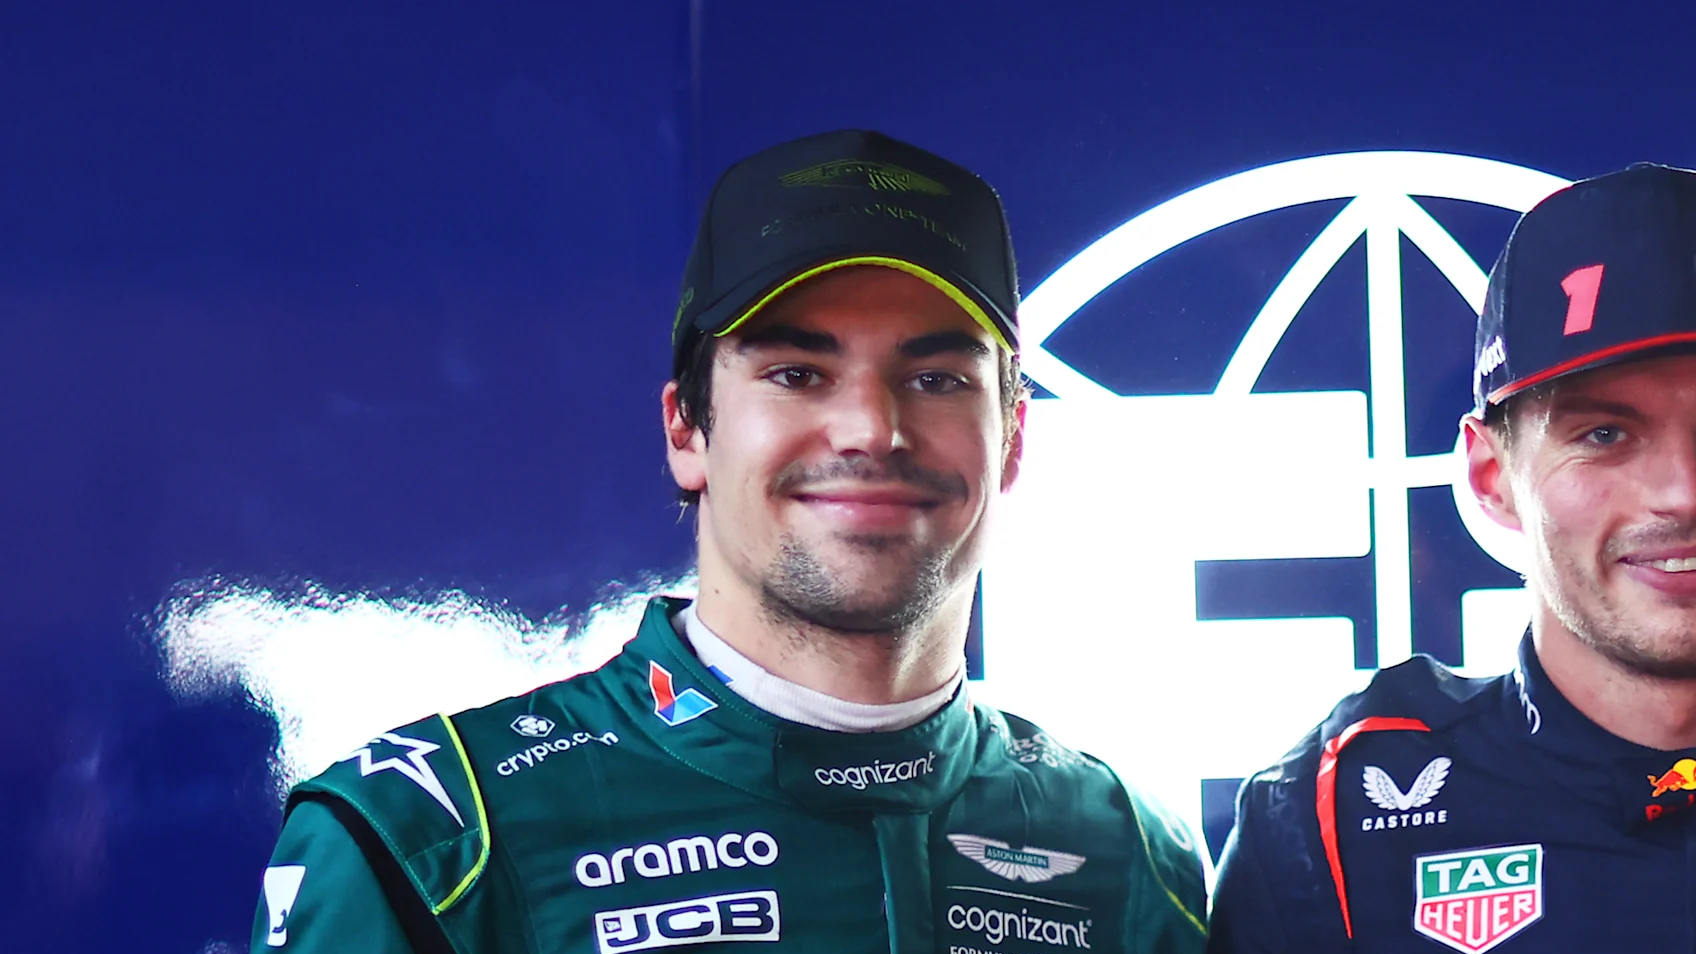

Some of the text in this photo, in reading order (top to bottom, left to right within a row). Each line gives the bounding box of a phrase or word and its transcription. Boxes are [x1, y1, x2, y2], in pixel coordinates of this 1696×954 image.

[1561, 264, 1604, 335] 1
[814, 751, 936, 790] cognizant
[1362, 809, 1448, 831] CASTORE
[575, 831, 779, 887] aramco
[986, 848, 1047, 867] ASTON MARTIN
[1427, 852, 1530, 894] TAG
[606, 896, 774, 948] JCB
[1423, 892, 1534, 947] HEUER
